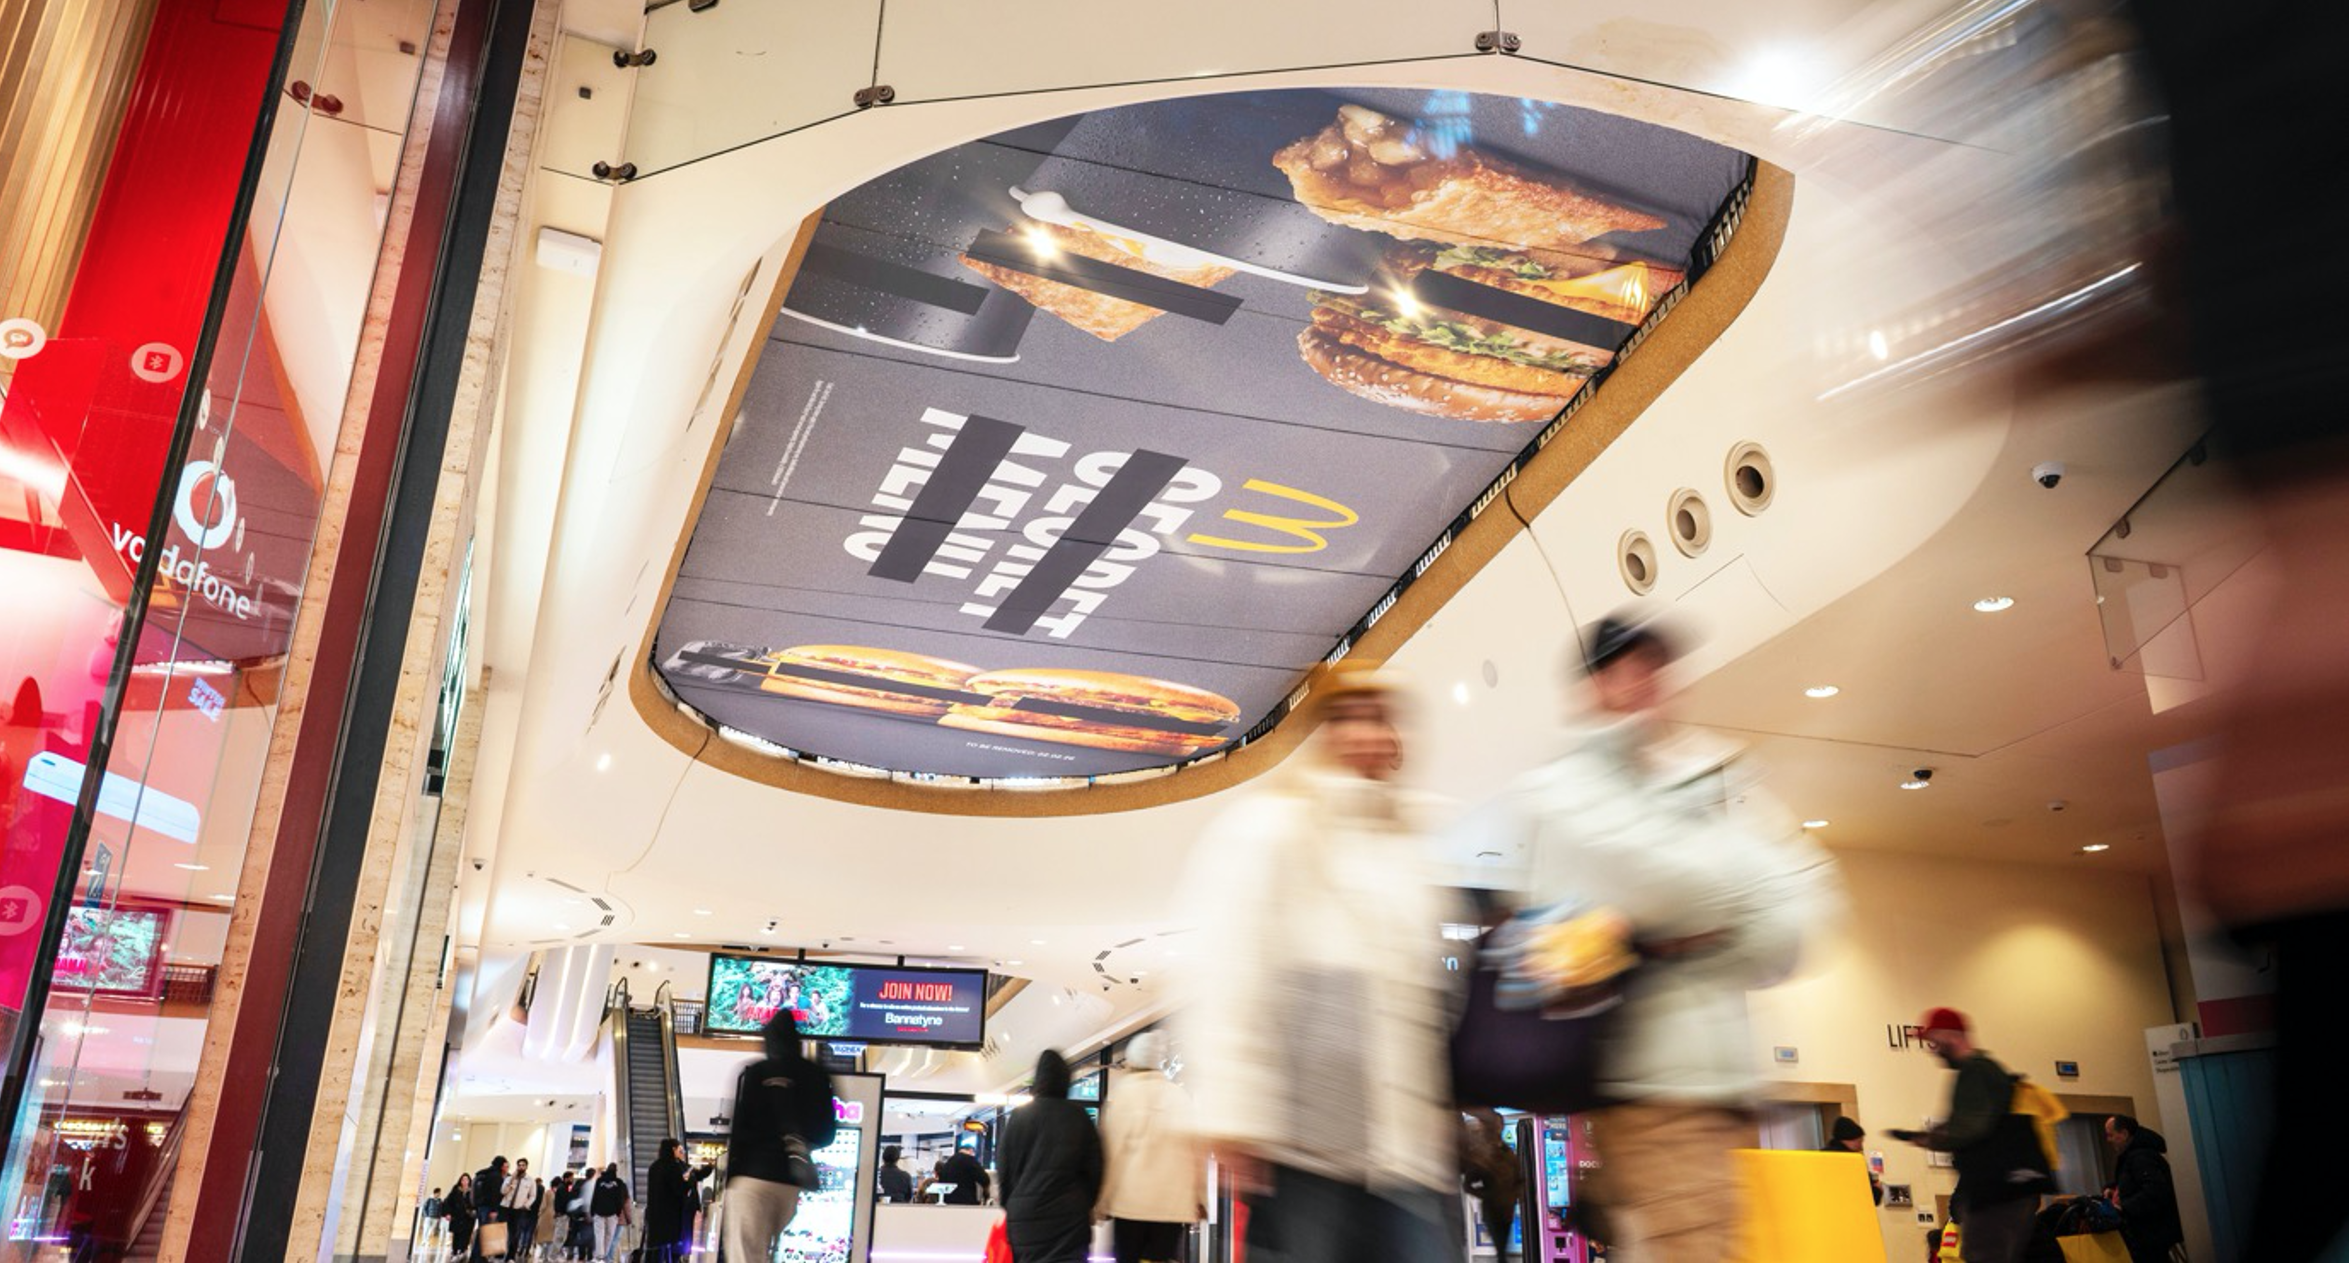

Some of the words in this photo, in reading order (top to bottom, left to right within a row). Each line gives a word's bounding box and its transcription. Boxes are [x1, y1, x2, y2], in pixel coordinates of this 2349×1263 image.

[113, 522, 251, 621] vodafone
[879, 981, 912, 1000] JOIN
[914, 983, 953, 1002] NOW!
[885, 1011, 943, 1028] Bannatyne
